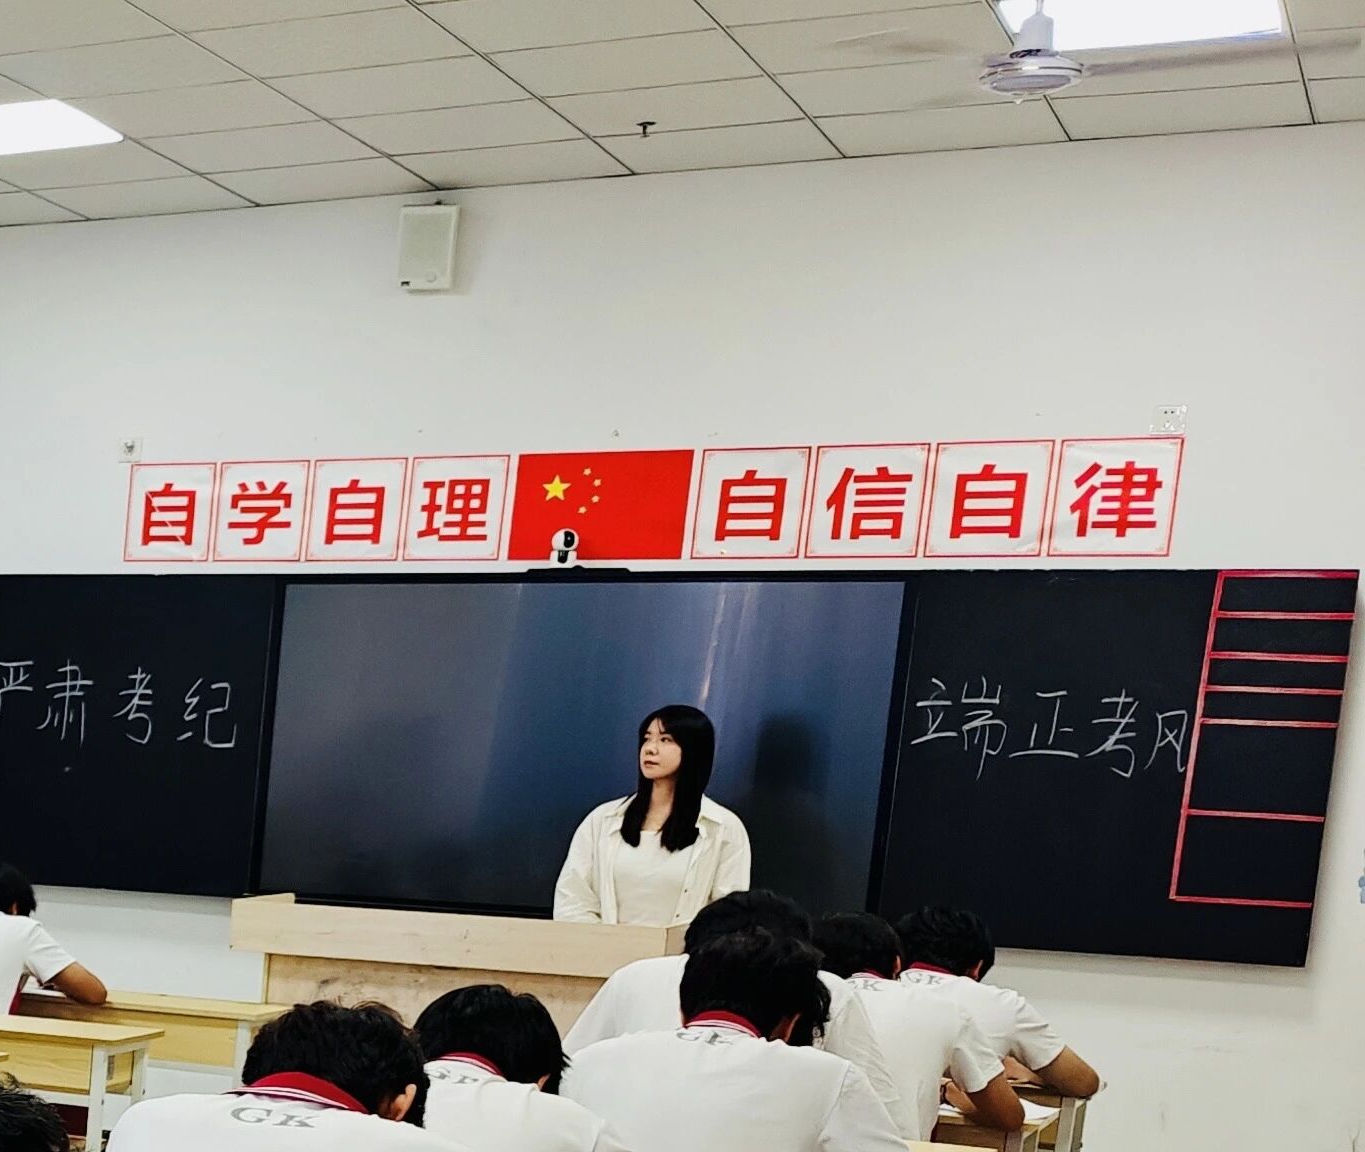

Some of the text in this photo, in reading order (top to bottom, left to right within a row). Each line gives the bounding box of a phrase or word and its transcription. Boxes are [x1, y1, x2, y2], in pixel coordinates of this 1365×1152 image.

[141, 460, 1163, 546] 自学自理 自信自律
[911, 676, 1186, 781] 端正考风
[231, 1107, 318, 1128] GK
